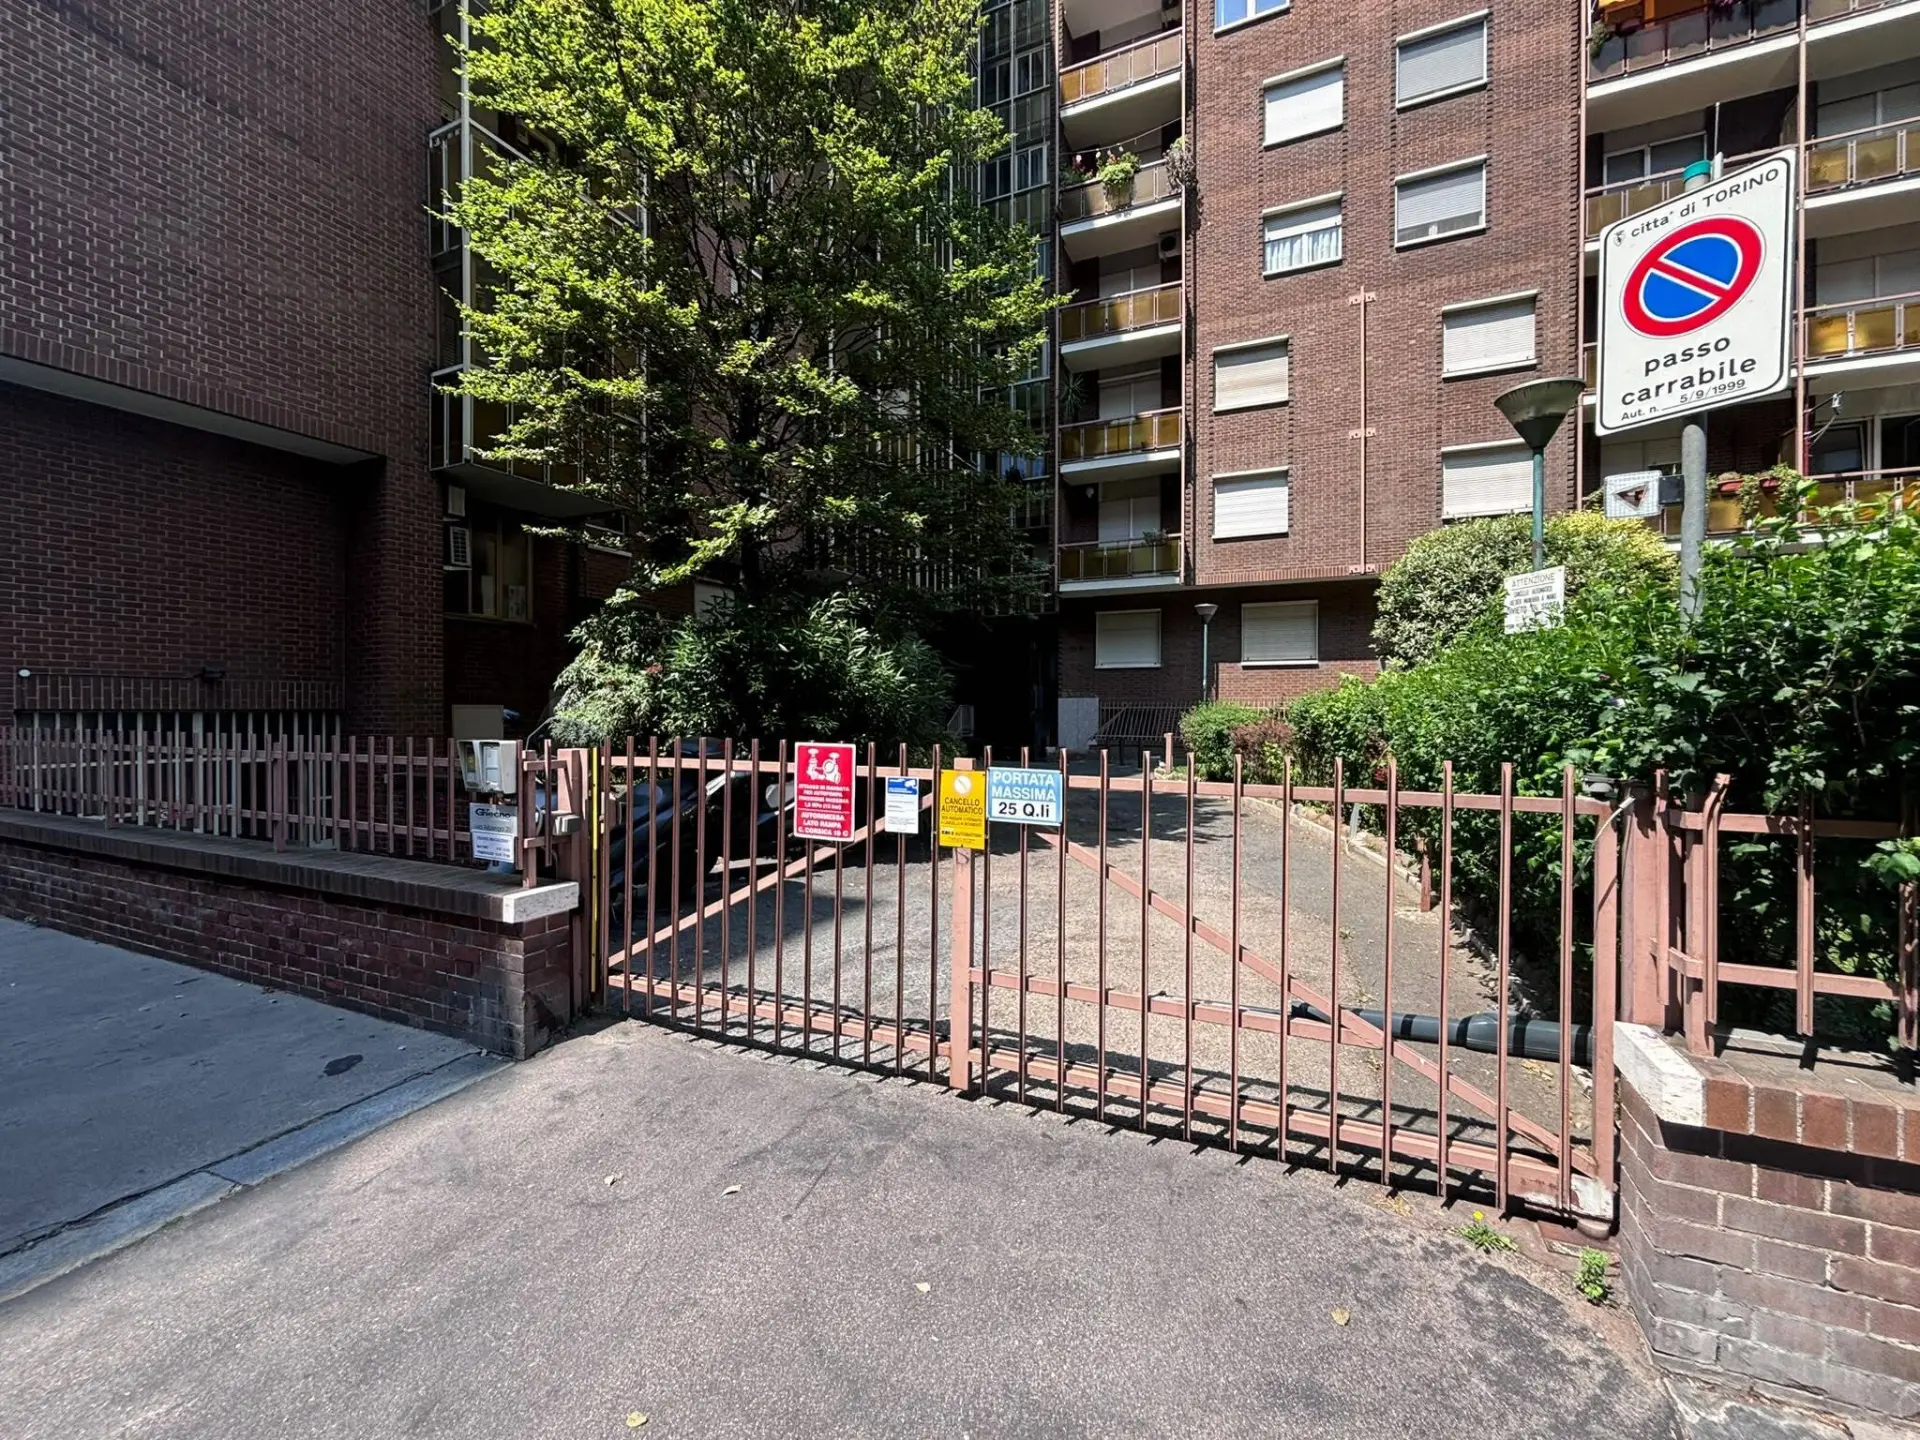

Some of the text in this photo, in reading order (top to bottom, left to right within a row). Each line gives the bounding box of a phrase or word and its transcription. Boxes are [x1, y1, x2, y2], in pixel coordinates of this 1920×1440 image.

[1680, 201, 1696, 218] di
[1702, 167, 1780, 208] TORINO
[1644, 336, 1731, 376] passo
[1621, 357, 1757, 407] carrabile
[1621, 378, 1747, 421] Aut. n. 5/9/1999
[1511, 573, 1555, 587] ATTENZIONE
[993, 771, 1056, 786] PORTATA
[991, 786, 1056, 800] MASSIMA
[944, 797, 980, 806] CANCELLO
[941, 805, 983, 815] AUTOMATICO
[998, 802, 1050, 818] 25 Q.li
[803, 819, 819, 827] LATO
